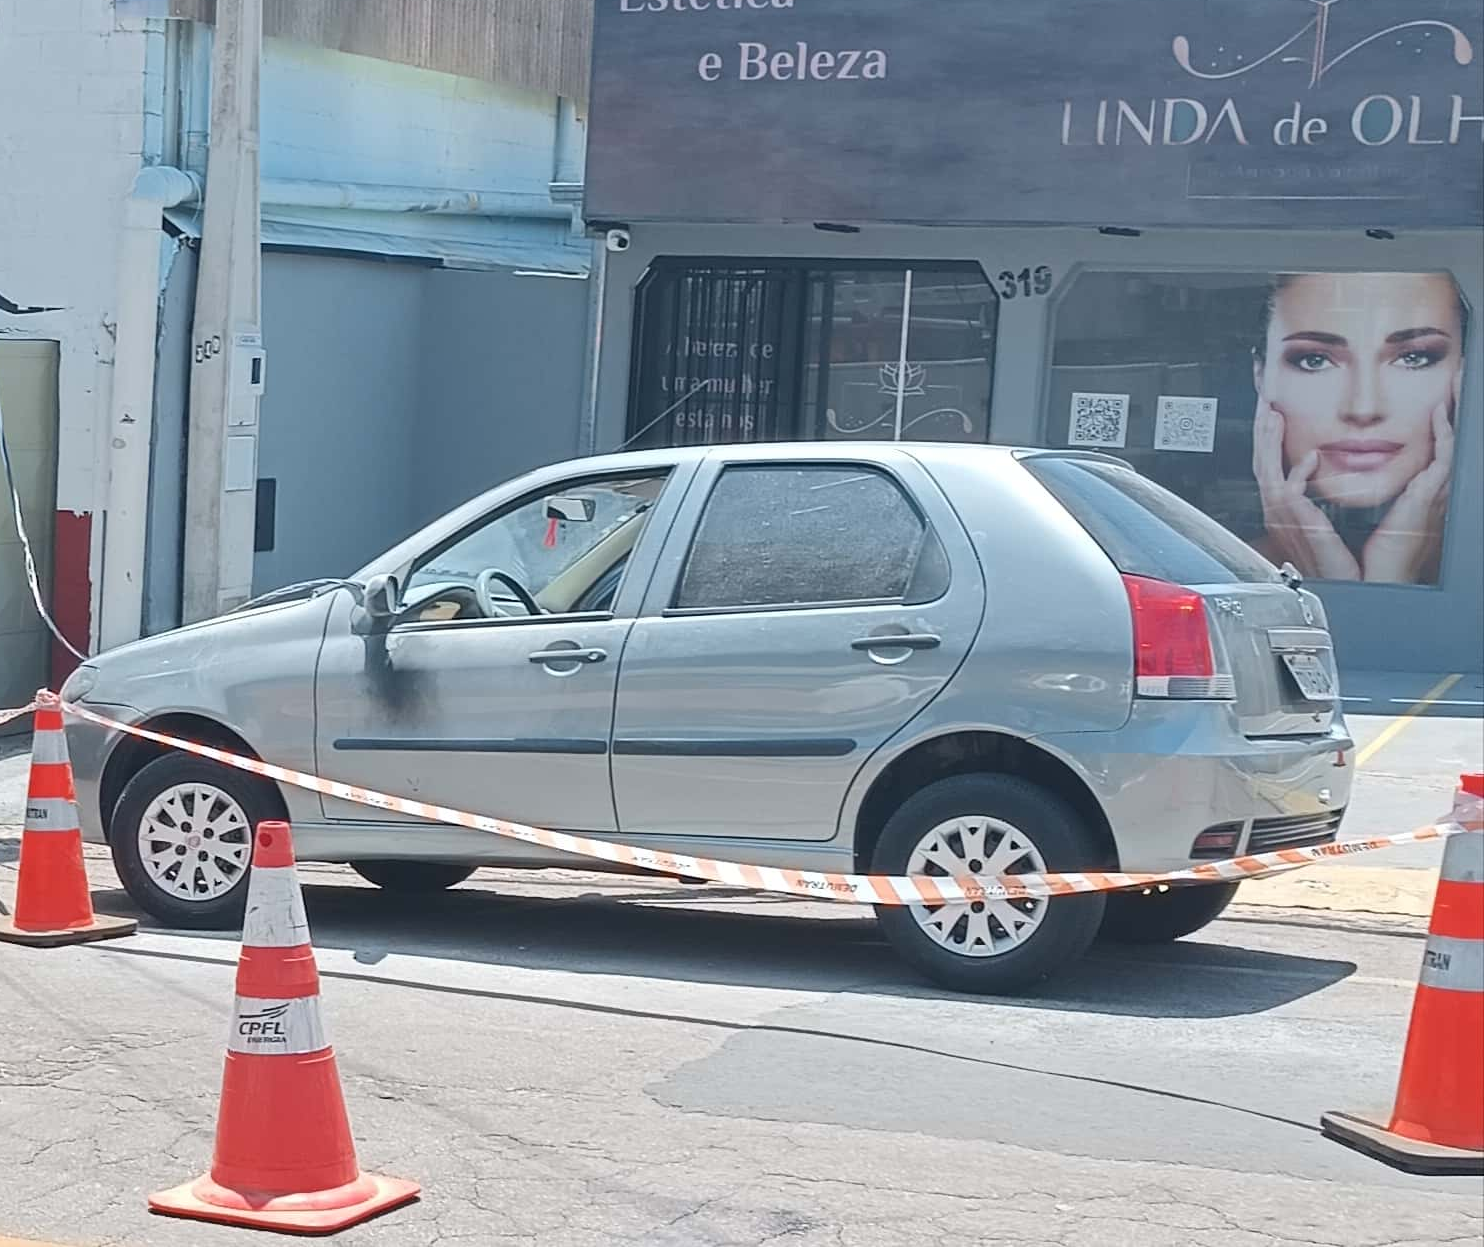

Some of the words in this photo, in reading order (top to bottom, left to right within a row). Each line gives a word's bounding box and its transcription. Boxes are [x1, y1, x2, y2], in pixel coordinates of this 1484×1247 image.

[698, 52, 722, 81] e
[738, 41, 887, 81] Beleza
[1061, 97, 1249, 145] LINDA
[1273, 101, 1328, 146] de
[998, 265, 1053, 299] 319
[238, 1021, 285, 1035] CPFL
